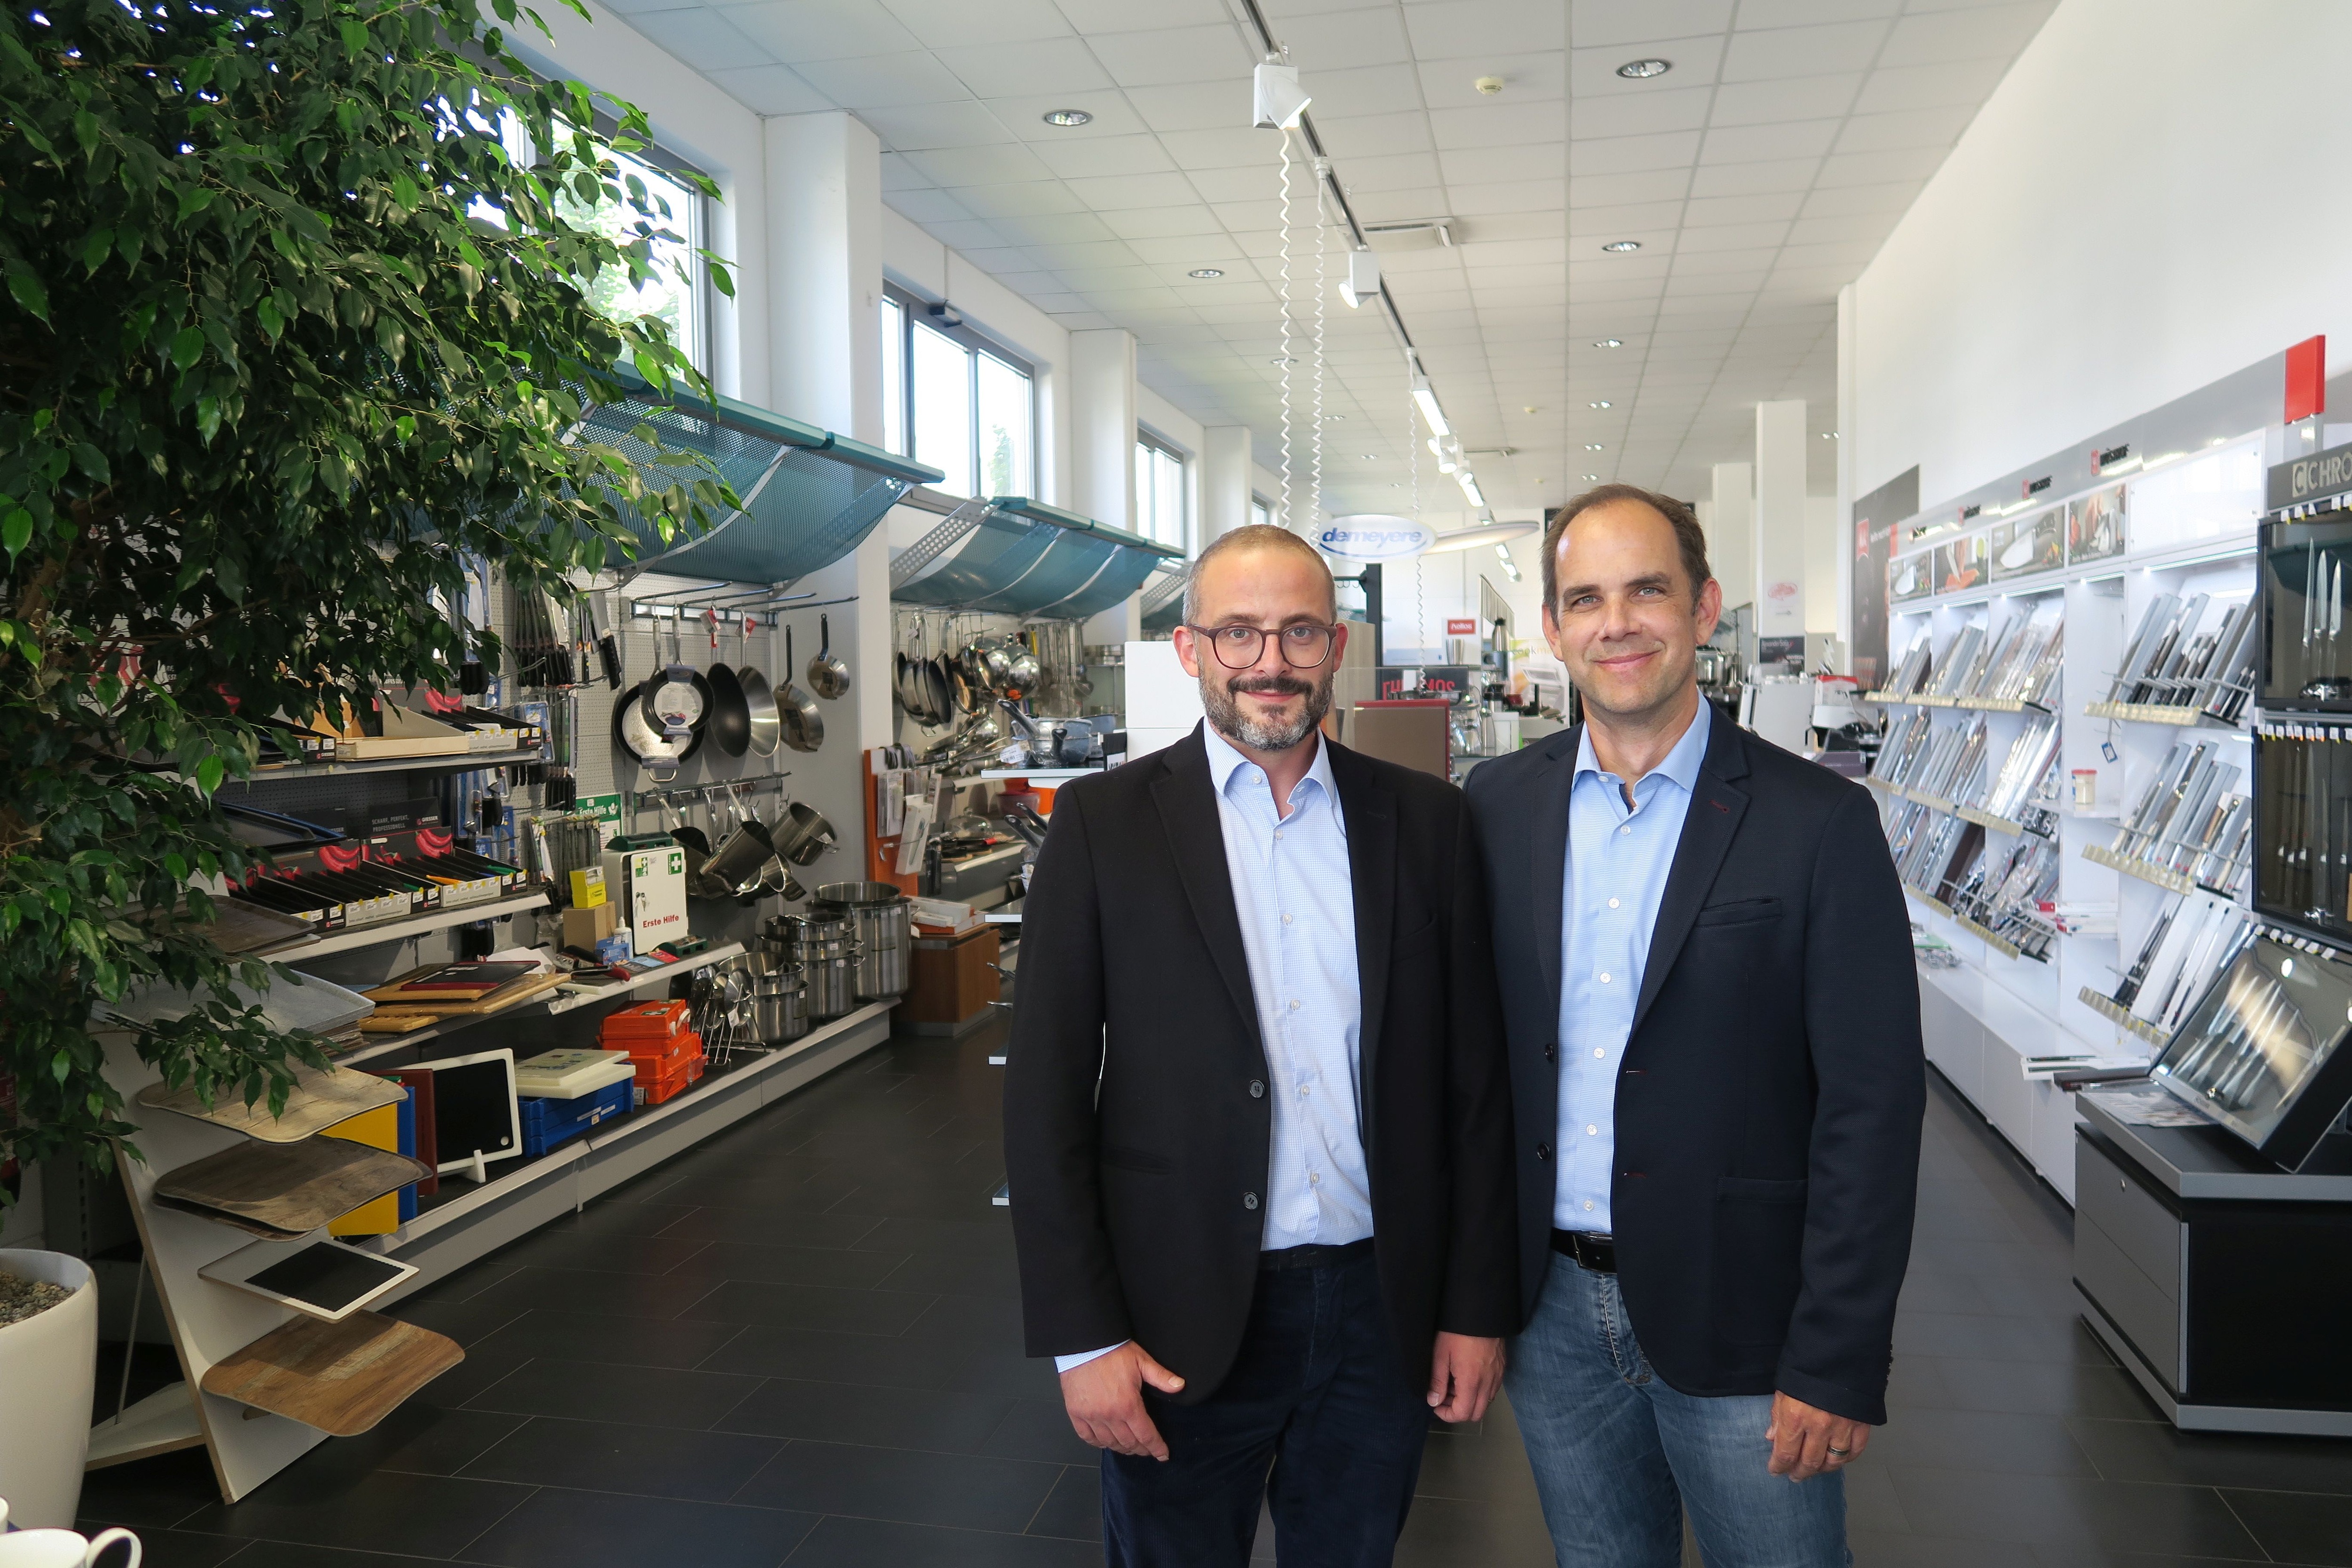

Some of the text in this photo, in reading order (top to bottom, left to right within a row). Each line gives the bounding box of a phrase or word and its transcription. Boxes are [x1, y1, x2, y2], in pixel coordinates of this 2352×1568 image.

[1322, 527, 1423, 549] demeyere
[594, 805, 606, 815] Hilfe
[643, 915, 679, 928] Erste Hilfe
